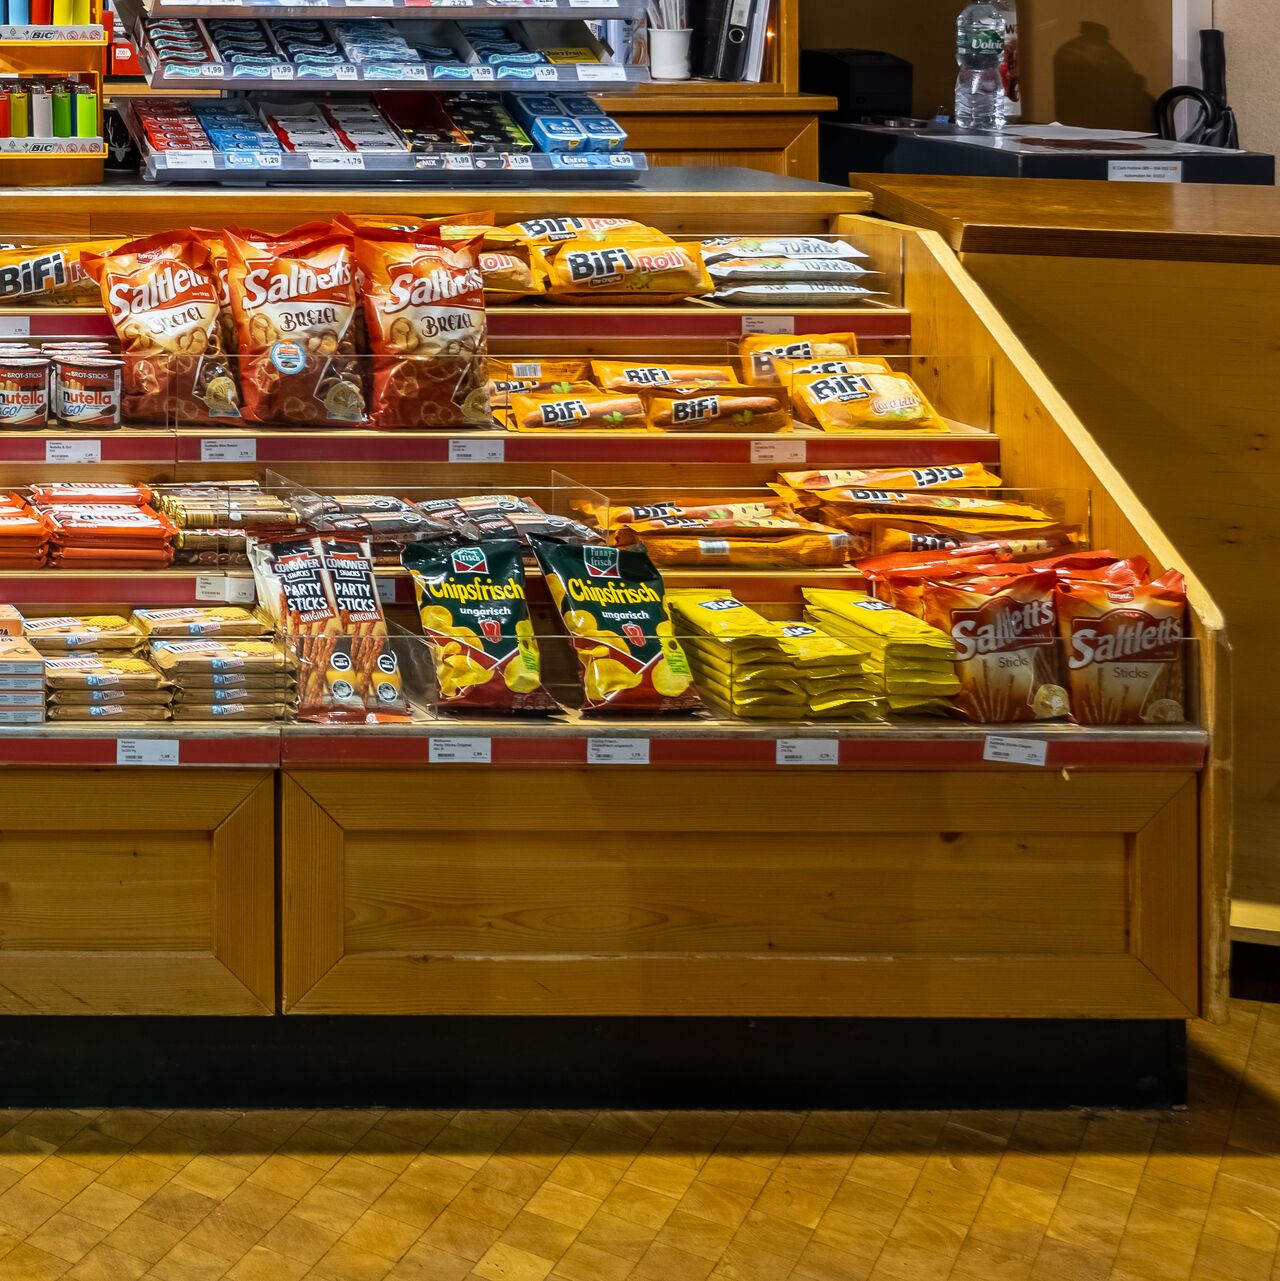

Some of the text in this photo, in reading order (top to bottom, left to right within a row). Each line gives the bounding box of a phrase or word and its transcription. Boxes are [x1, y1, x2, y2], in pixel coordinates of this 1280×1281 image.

[971, 38, 1004, 50] Volvic
[570, 249, 684, 281] BiFi Roll
[279, 308, 339, 332] BREZEL
[420, 314, 474, 338] BREZEL
[275, 559, 321, 574] CONOWER
[284, 583, 321, 597] PARTY
[429, 577, 525, 604] Chipsfrisch
[568, 578, 661, 604] Chipsfrisch
[287, 596, 327, 611] STICKS
[299, 609, 334, 623] ORIGINAL
[459, 606, 512, 618] ungarisch
[601, 609, 650, 620] ungarisch
[952, 599, 1054, 661] Saltletts
[1067, 615, 1183, 669] Saltletts
[997, 655, 1029, 668] Sticks
[1113, 666, 1149, 680] Sticks
